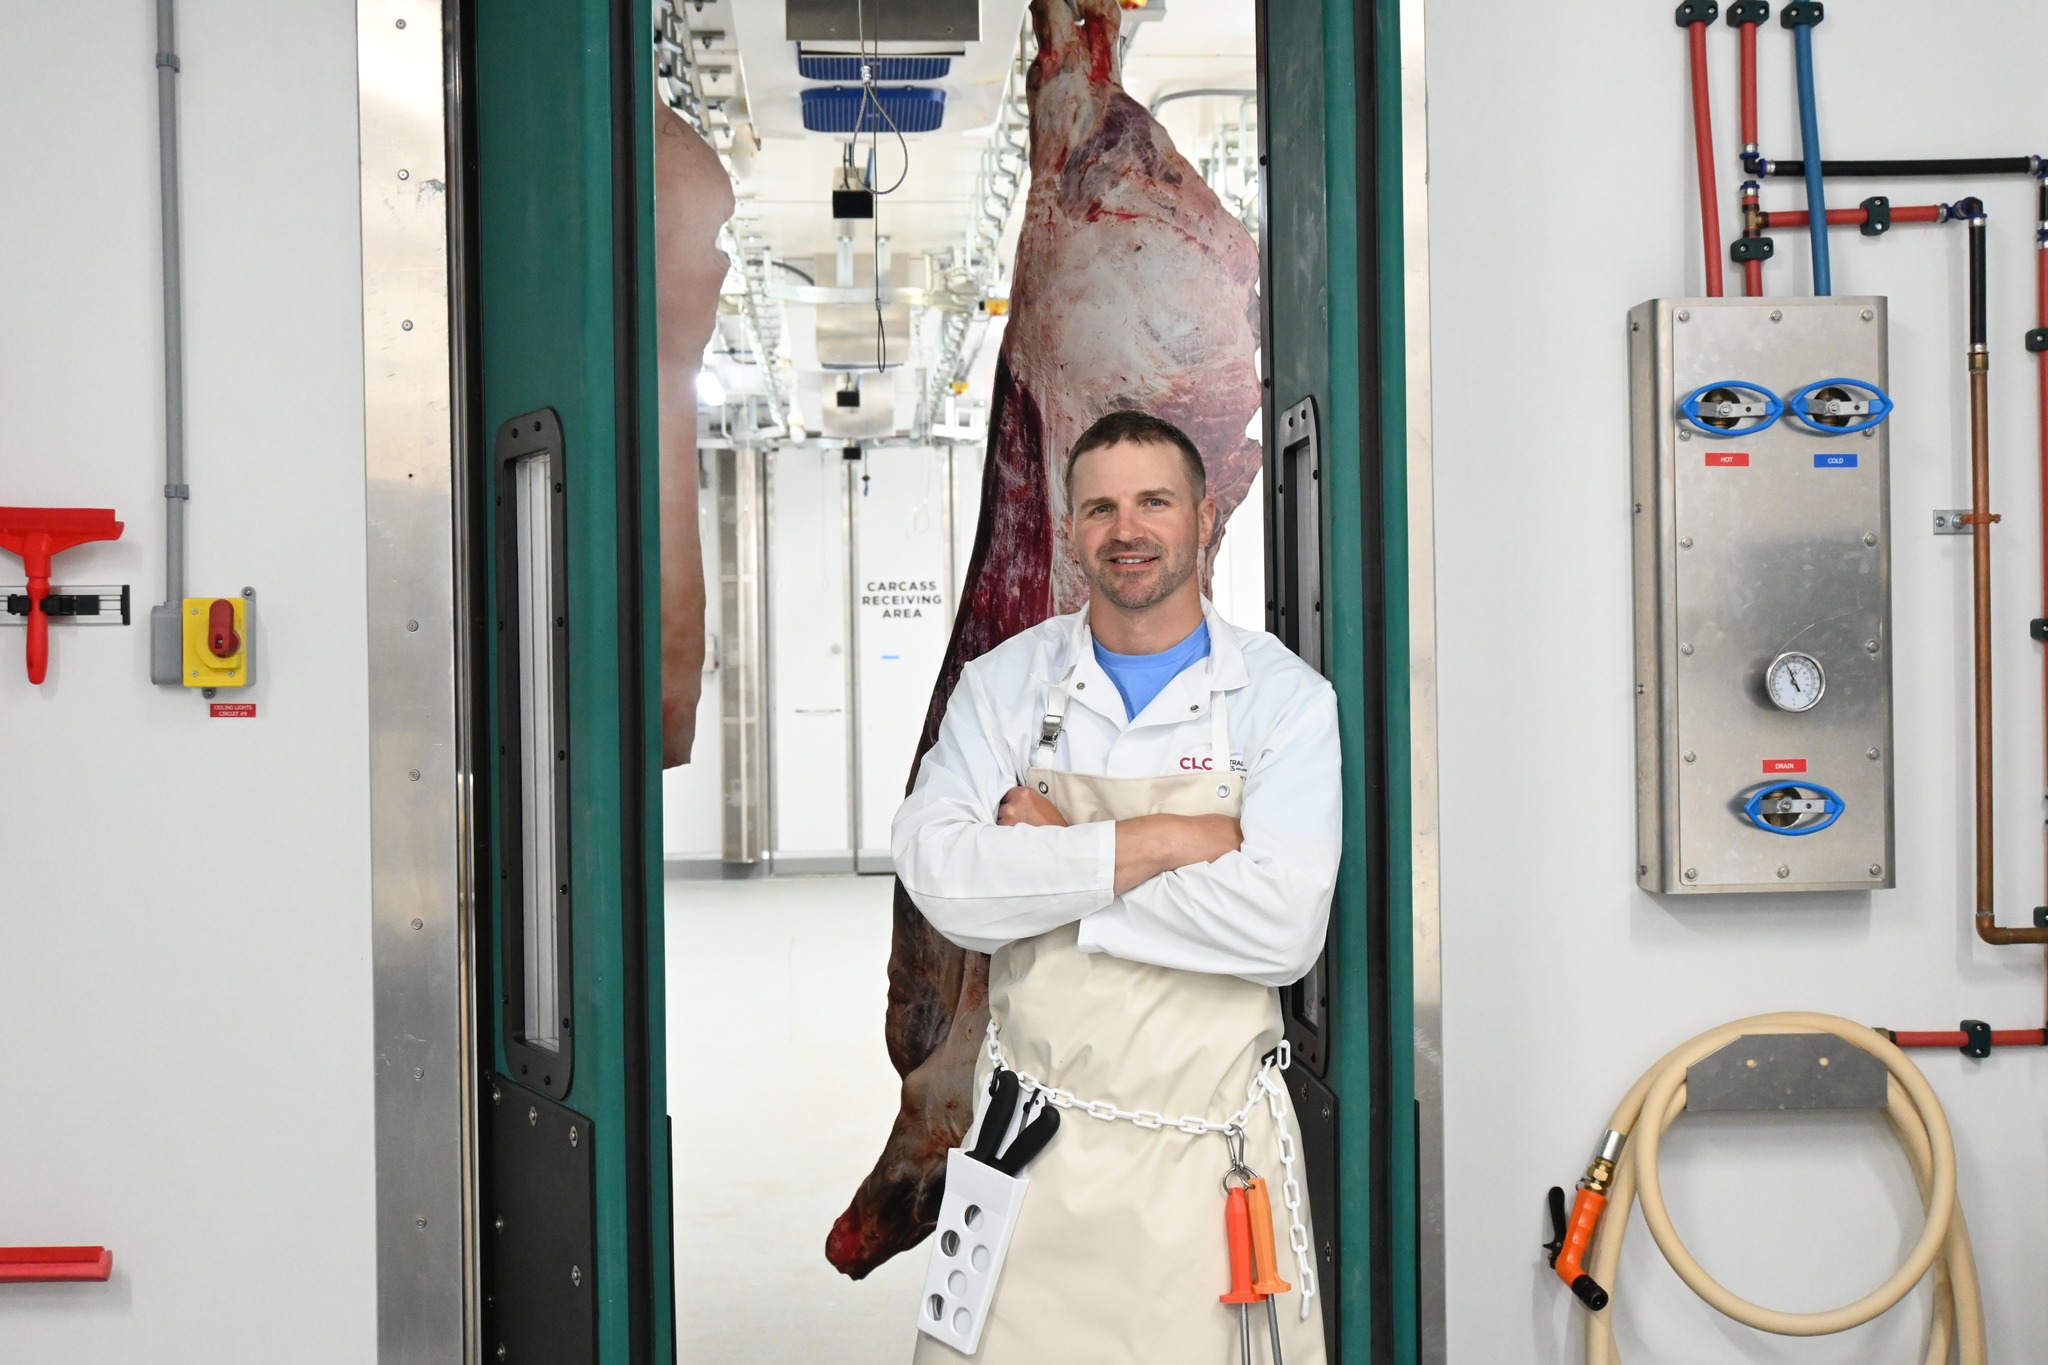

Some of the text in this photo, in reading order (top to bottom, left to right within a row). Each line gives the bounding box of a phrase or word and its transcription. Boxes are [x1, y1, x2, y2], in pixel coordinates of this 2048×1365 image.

[867, 581, 937, 592] CARCASS
[862, 595, 942, 606] RECEIVING
[882, 608, 922, 619] AREA
[1179, 757, 1213, 771] CLC
